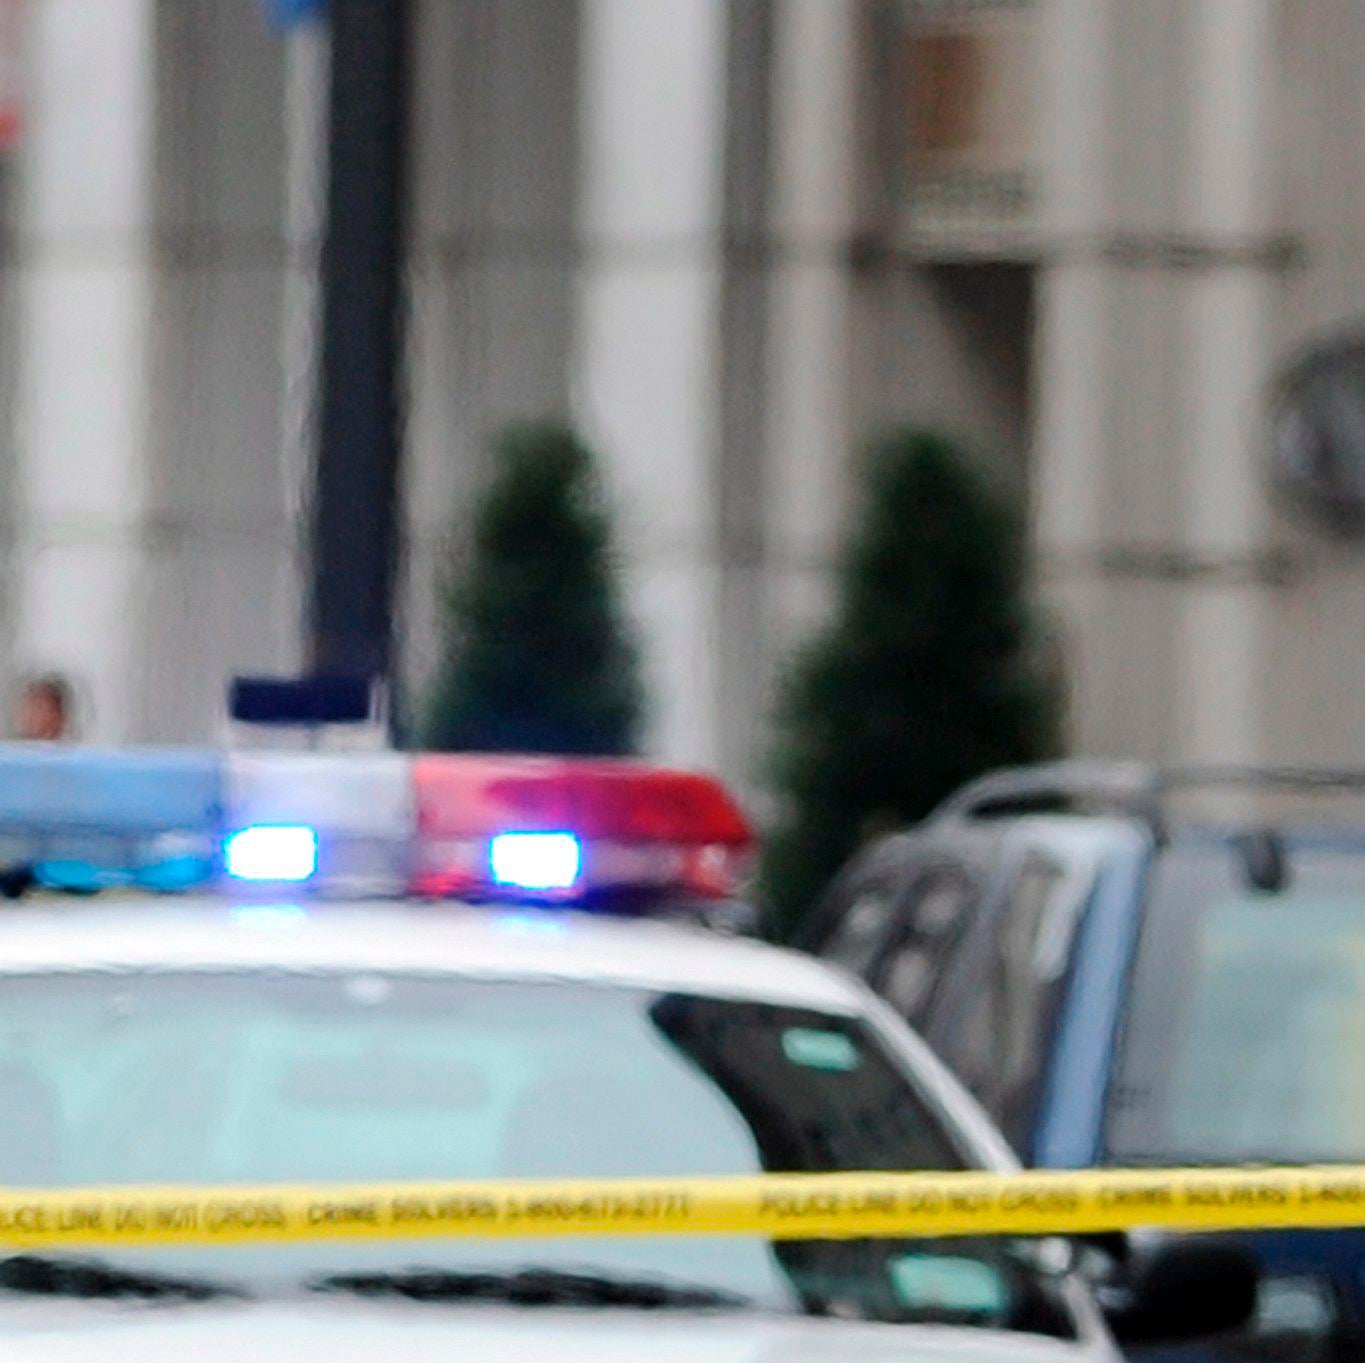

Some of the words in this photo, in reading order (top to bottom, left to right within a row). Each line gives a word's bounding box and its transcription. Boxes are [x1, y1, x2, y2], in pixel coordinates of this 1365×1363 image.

[758, 1187, 839, 1216] POLICE
[849, 1186, 897, 1214] LINE
[909, 1185, 945, 1213] DO
[948, 1184, 991, 1212] NOT
[998, 1183, 1079, 1213] CROSS
[1099, 1183, 1172, 1208] CRIME
[1185, 1180, 1288, 1205] SOLVERS
[307, 1201, 378, 1226] CRIME
